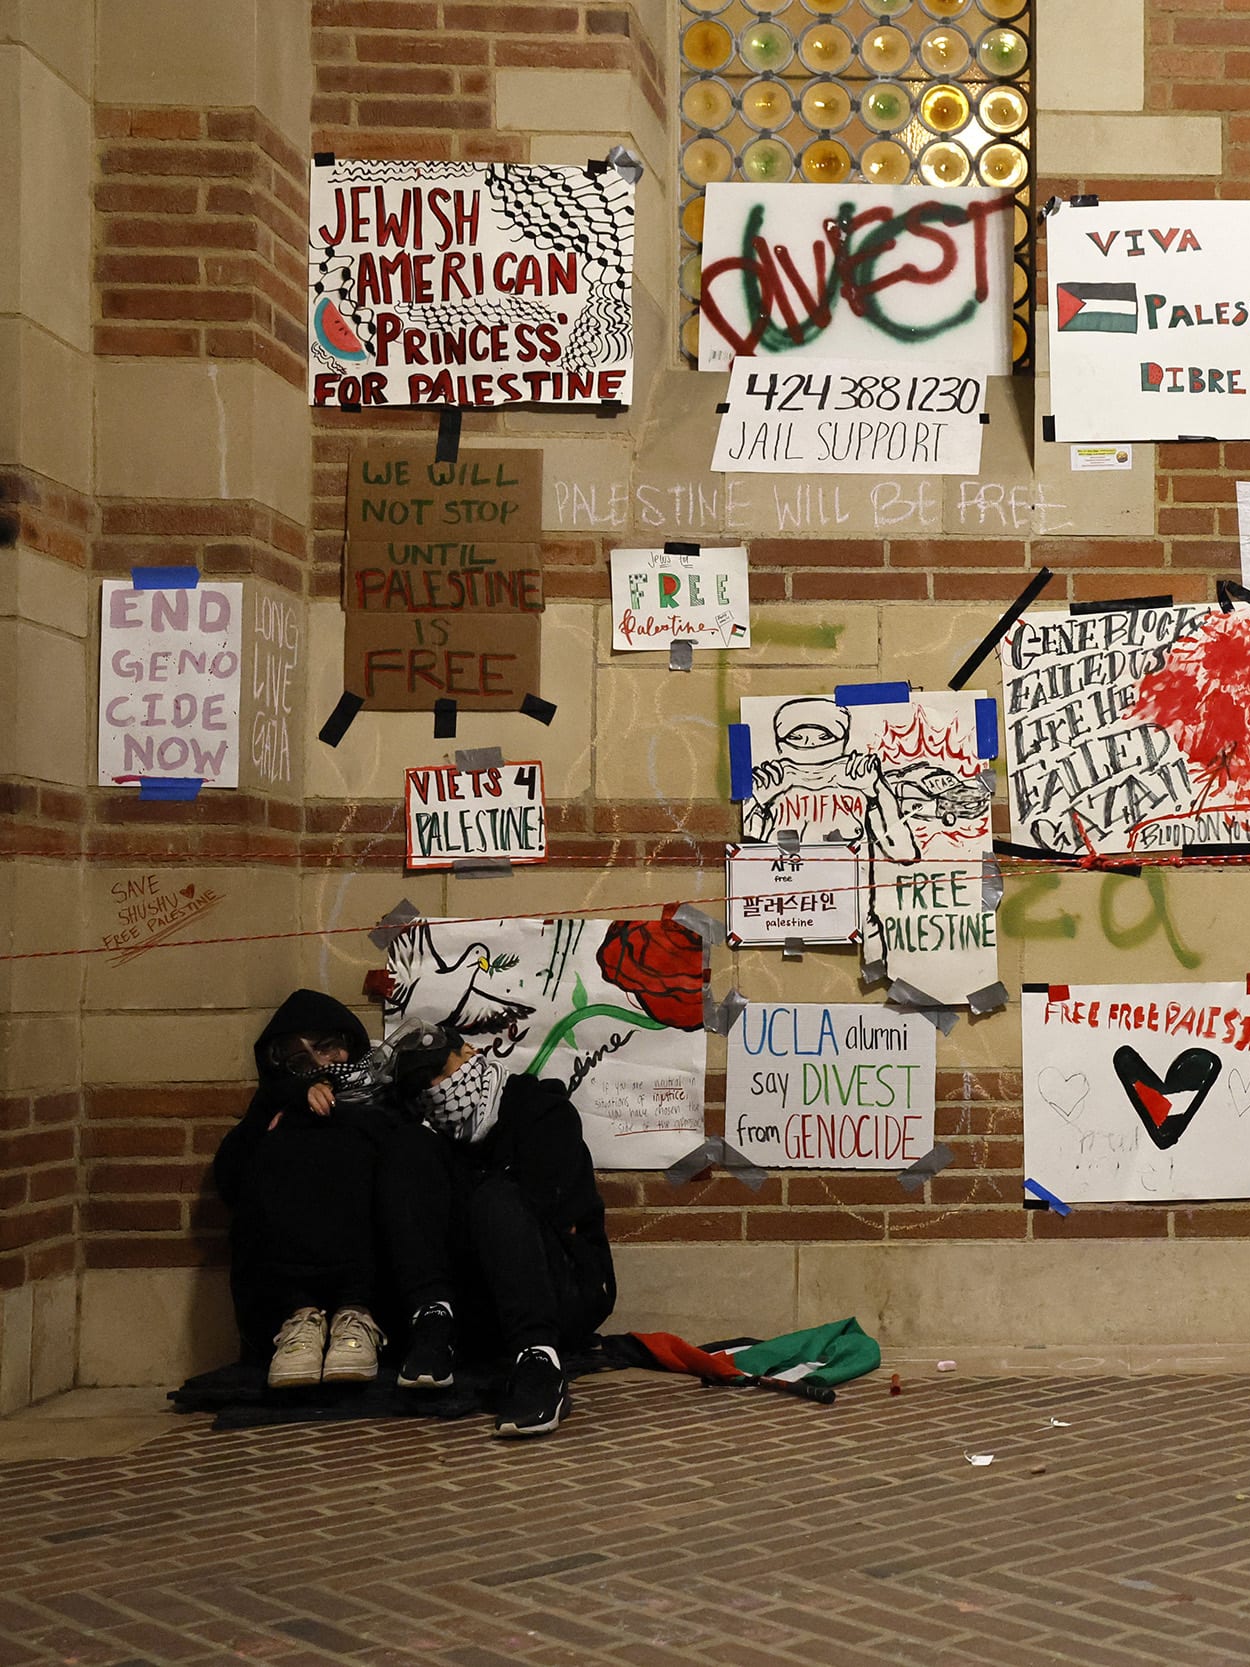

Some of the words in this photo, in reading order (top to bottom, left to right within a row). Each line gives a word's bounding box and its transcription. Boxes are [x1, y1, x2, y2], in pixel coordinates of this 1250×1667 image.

[319, 186, 480, 251] JEWISH
[1086, 228, 1202, 257] VIVA
[357, 249, 577, 308] AMERICAN
[313, 371, 389, 405] FOR
[408, 369, 627, 406] PALESTINE
[729, 422, 804, 462] JAIL
[817, 422, 948, 462] SUPPORT
[361, 461, 410, 486] WE
[428, 460, 519, 486] WILL
[362, 500, 434, 526] NOT
[443, 500, 520, 525] STOP
[553, 480, 750, 528] PALESTINE
[774, 484, 850, 530] WILL
[870, 481, 938, 527] BE
[957, 481, 1073, 533] FREE
[388, 542, 497, 565] UNTIL
[355, 567, 542, 613] PALESTINE
[629, 573, 730, 609] FREE
[110, 589, 232, 633] END
[254, 591, 299, 664] LONG
[619, 609, 719, 645] Palestine
[414, 619, 450, 646] IS
[1011, 619, 1098, 671] GENE
[1101, 606, 1212, 652] BLOCK
[112, 650, 238, 682] GENO
[253, 642, 295, 716] LIVE
[364, 649, 518, 698] FREE
[1008, 649, 1126, 715] FAILED
[106, 694, 227, 731] CIDE
[1008, 697, 1092, 764] LIKE
[1090, 682, 1137, 729] HE
[123, 734, 227, 776] NOW
[252, 711, 292, 784] GAZA
[409, 767, 502, 805] VIETS
[514, 766, 537, 800] 4
[1010, 723, 1171, 825] FAILED
[778, 794, 864, 827] INTIFADA
[416, 806, 545, 857] PALESTINE!
[111, 875, 161, 905] SAVE
[774, 875, 793, 883] free
[896, 870, 969, 910] FREE
[103, 927, 140, 950] FREE
[146, 888, 218, 933] PALESTINE
[765, 917, 814, 931] palestine
[885, 912, 996, 952] PALESTINE
[743, 1008, 839, 1056] UCLA
[845, 1015, 907, 1050] alumni
[1045, 1001, 1101, 1028] FREE
[1108, 1002, 1159, 1032] FREE
[751, 1072, 789, 1108] say
[803, 1063, 920, 1109] DIVEST
[737, 1113, 780, 1146] from
[785, 1114, 922, 1160] GENOCIDE
